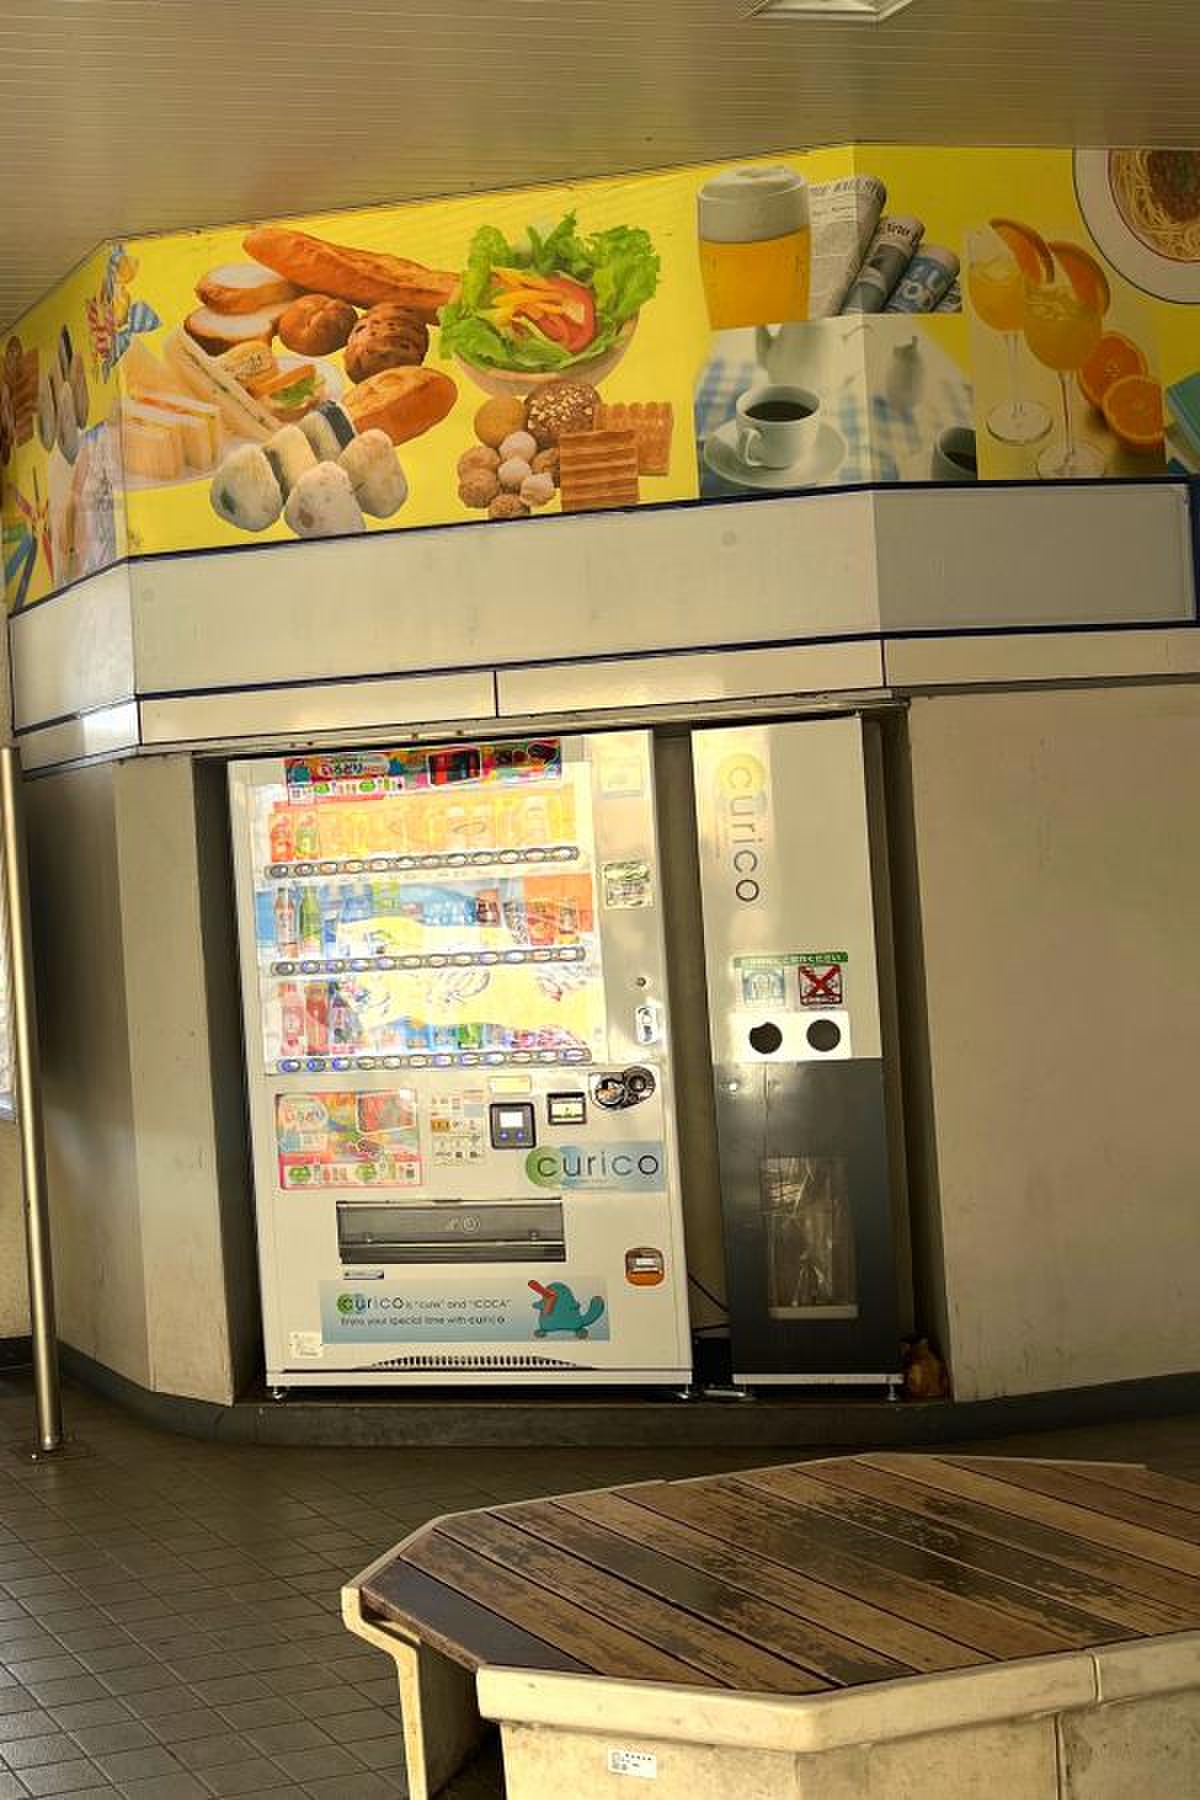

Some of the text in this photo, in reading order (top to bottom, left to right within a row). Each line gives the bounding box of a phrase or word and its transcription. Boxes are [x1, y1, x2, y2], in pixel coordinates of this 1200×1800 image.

[729, 766, 763, 903] curico
[537, 1151, 660, 1177] curico
[339, 1295, 405, 1313] curico
